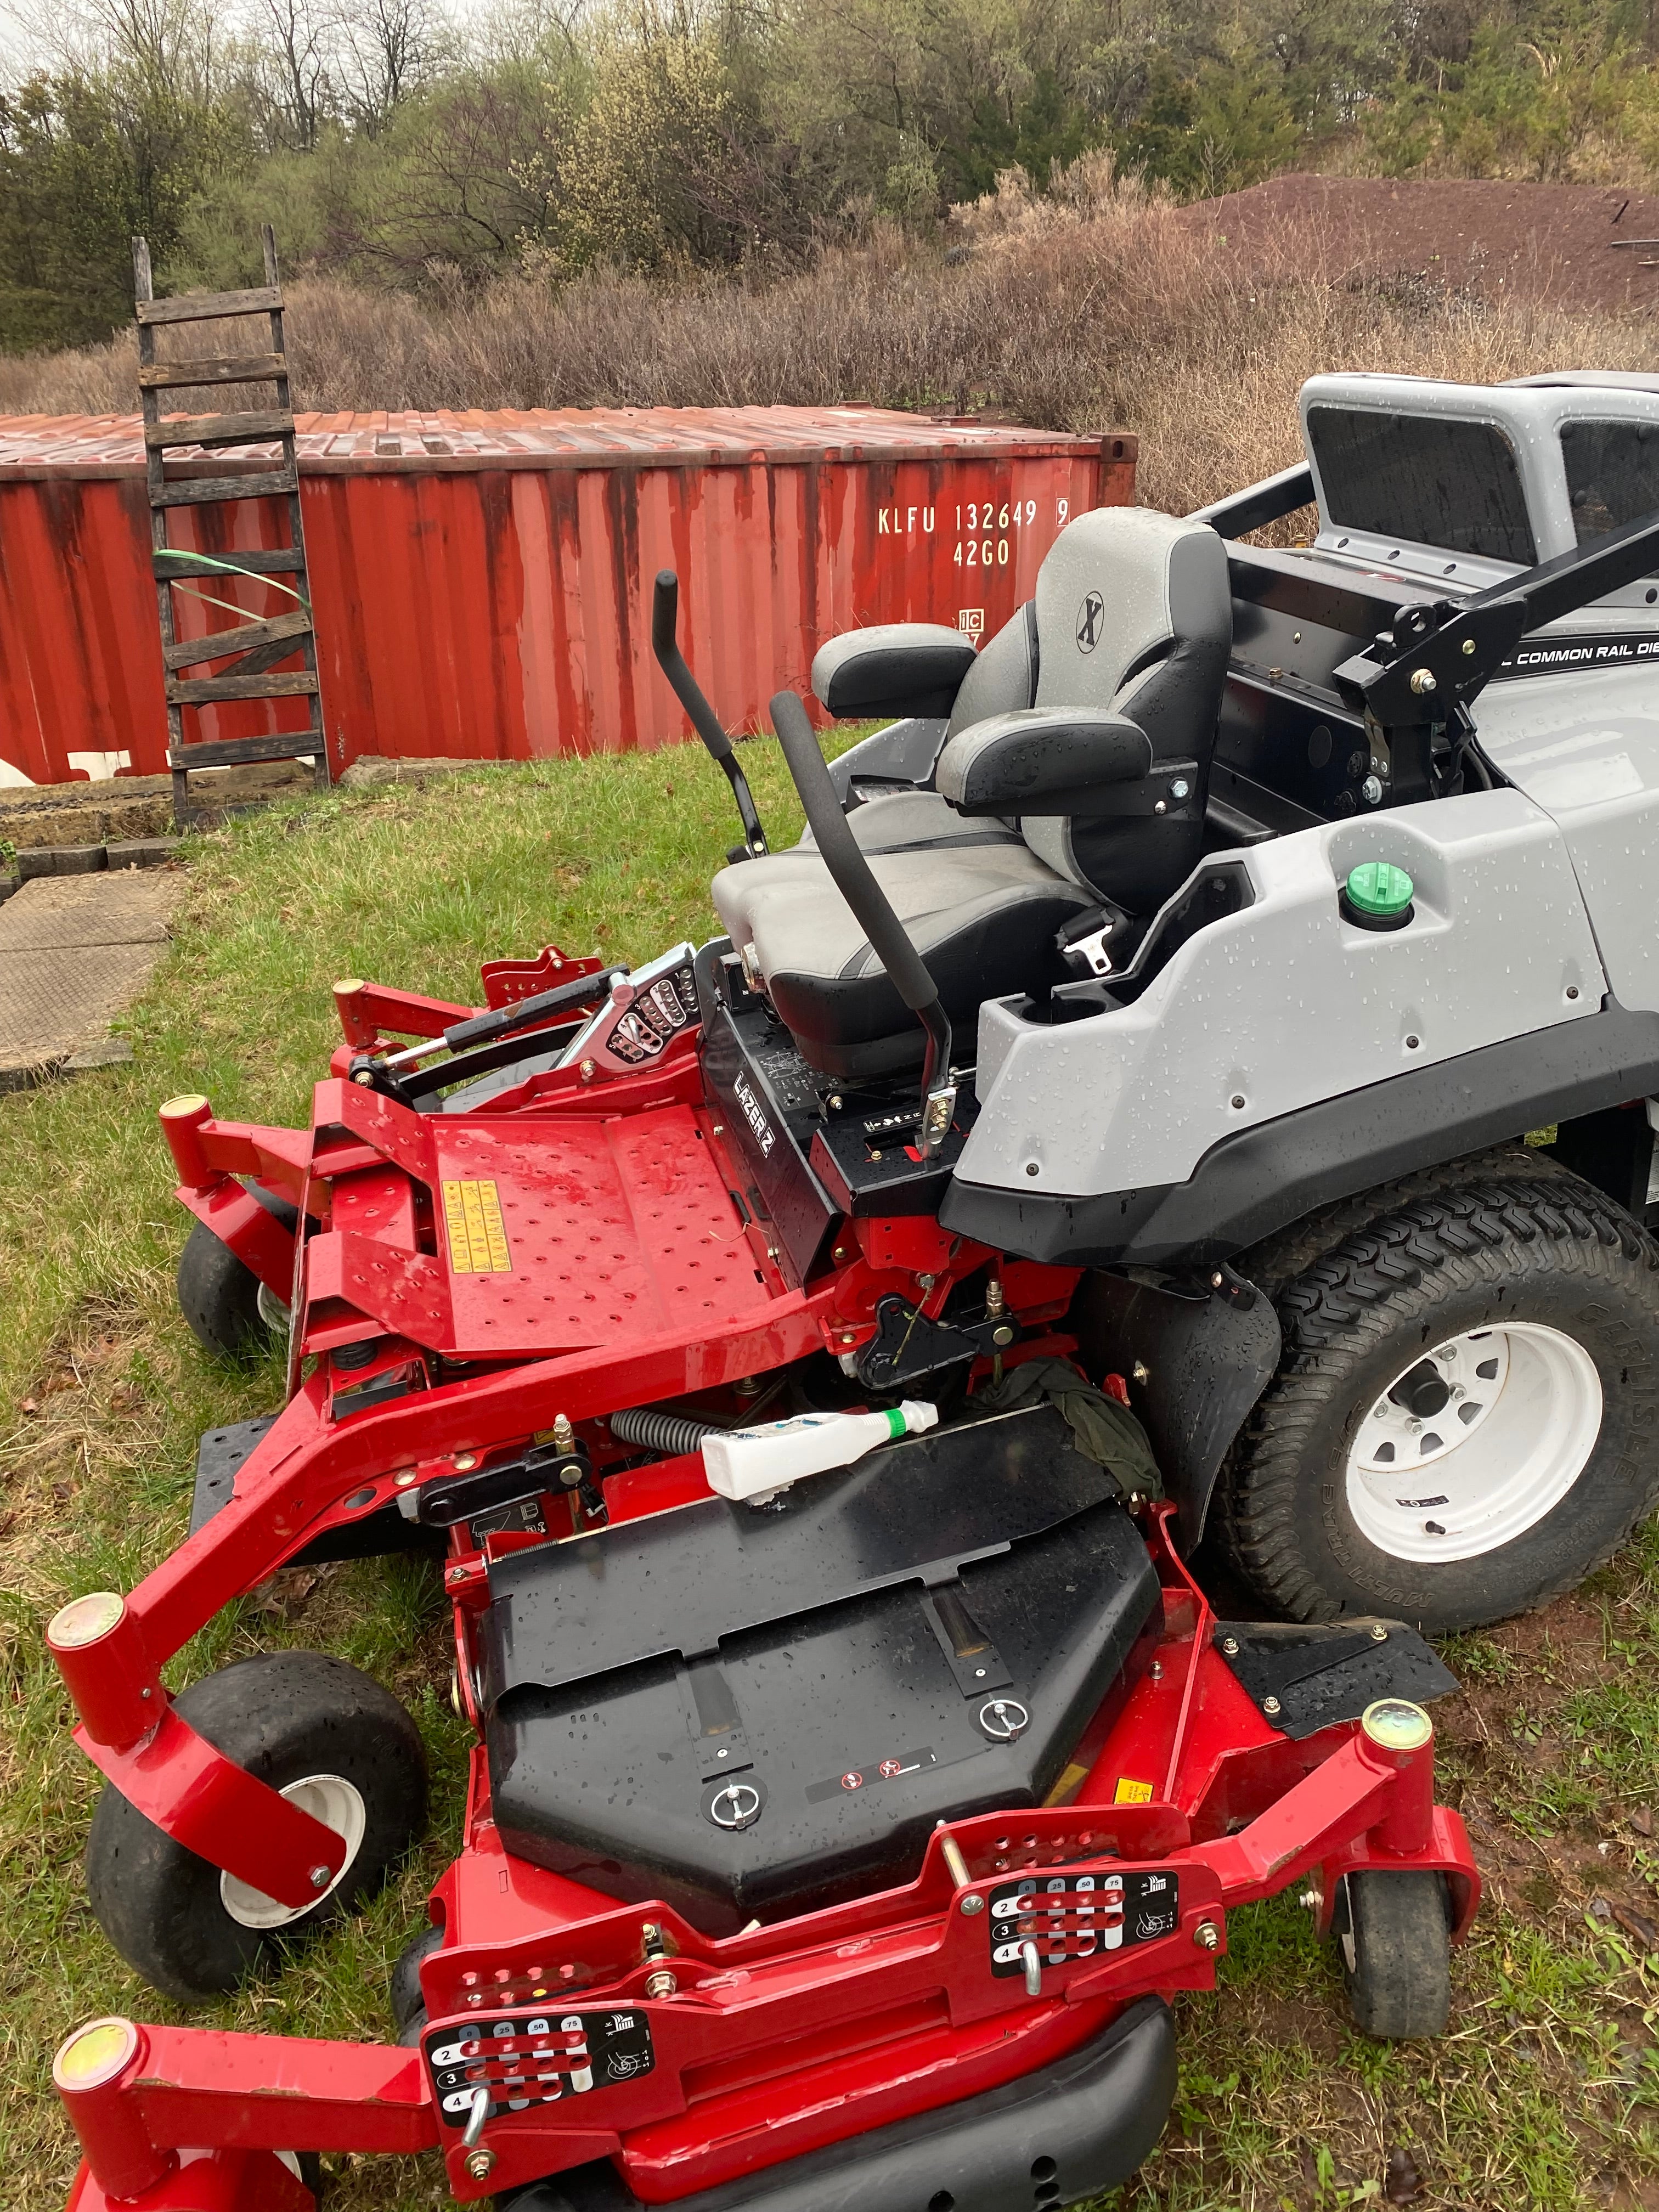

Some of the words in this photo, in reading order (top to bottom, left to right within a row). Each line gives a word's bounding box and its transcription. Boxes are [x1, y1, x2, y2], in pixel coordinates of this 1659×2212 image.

[879, 506, 934, 534] KLFU
[956, 500, 1036, 531] 132649
[1058, 499, 1069, 525] 9
[1517, 647, 1594, 665] COMMON
[1596, 644, 1633, 658] RAIL
[733, 1070, 766, 1143] LAZER
[759, 1126, 776, 1159] Z
[1571, 1302, 1656, 1487] CARLISLE
[1321, 1483, 1352, 1567] TRAC
[1347, 1565, 1436, 1607] MULTI
[1000, 1903, 1008, 1913] 2
[1001, 1926, 1009, 1936] 3
[1002, 1948, 1009, 1957] 4
[441, 2050, 451, 2061] 2
[447, 2073, 456, 2084] 3
[453, 2097, 462, 2107] 4
